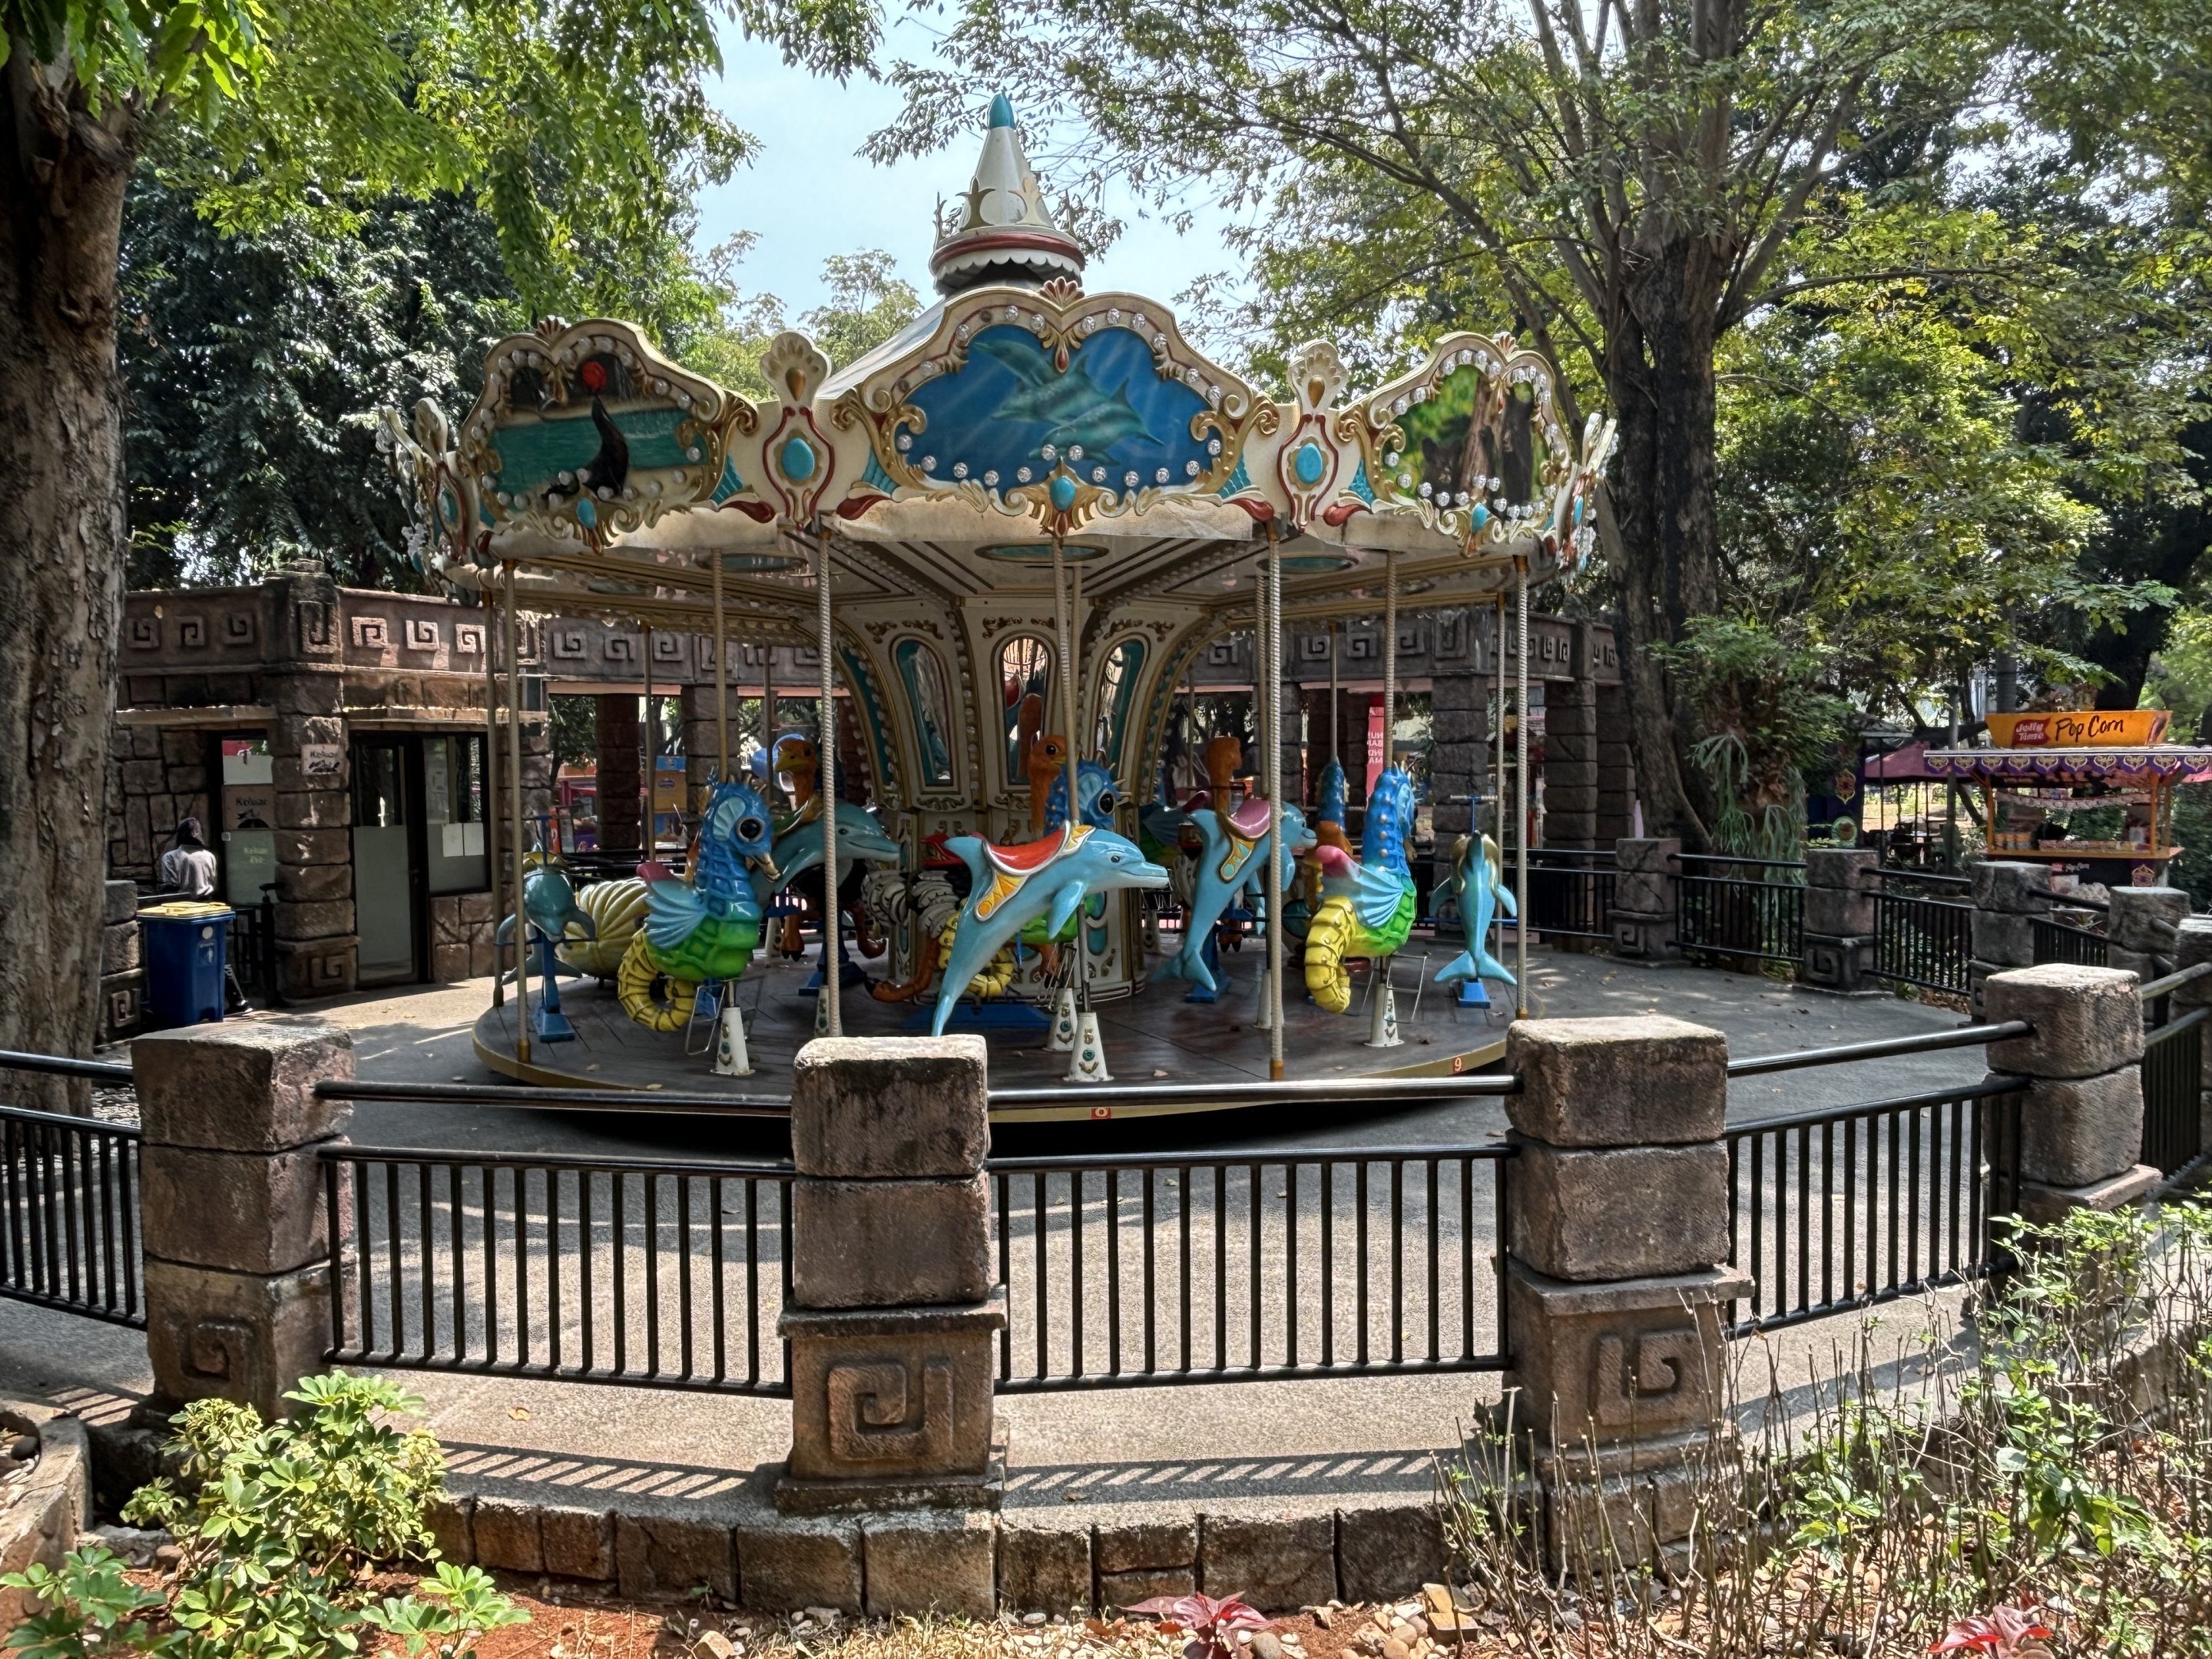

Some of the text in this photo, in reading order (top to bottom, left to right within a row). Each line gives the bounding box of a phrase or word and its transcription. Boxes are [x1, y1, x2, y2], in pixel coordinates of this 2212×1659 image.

[2055, 715, 2124, 743] Pop Corn
[1455, 1057, 1462, 1072] 9
